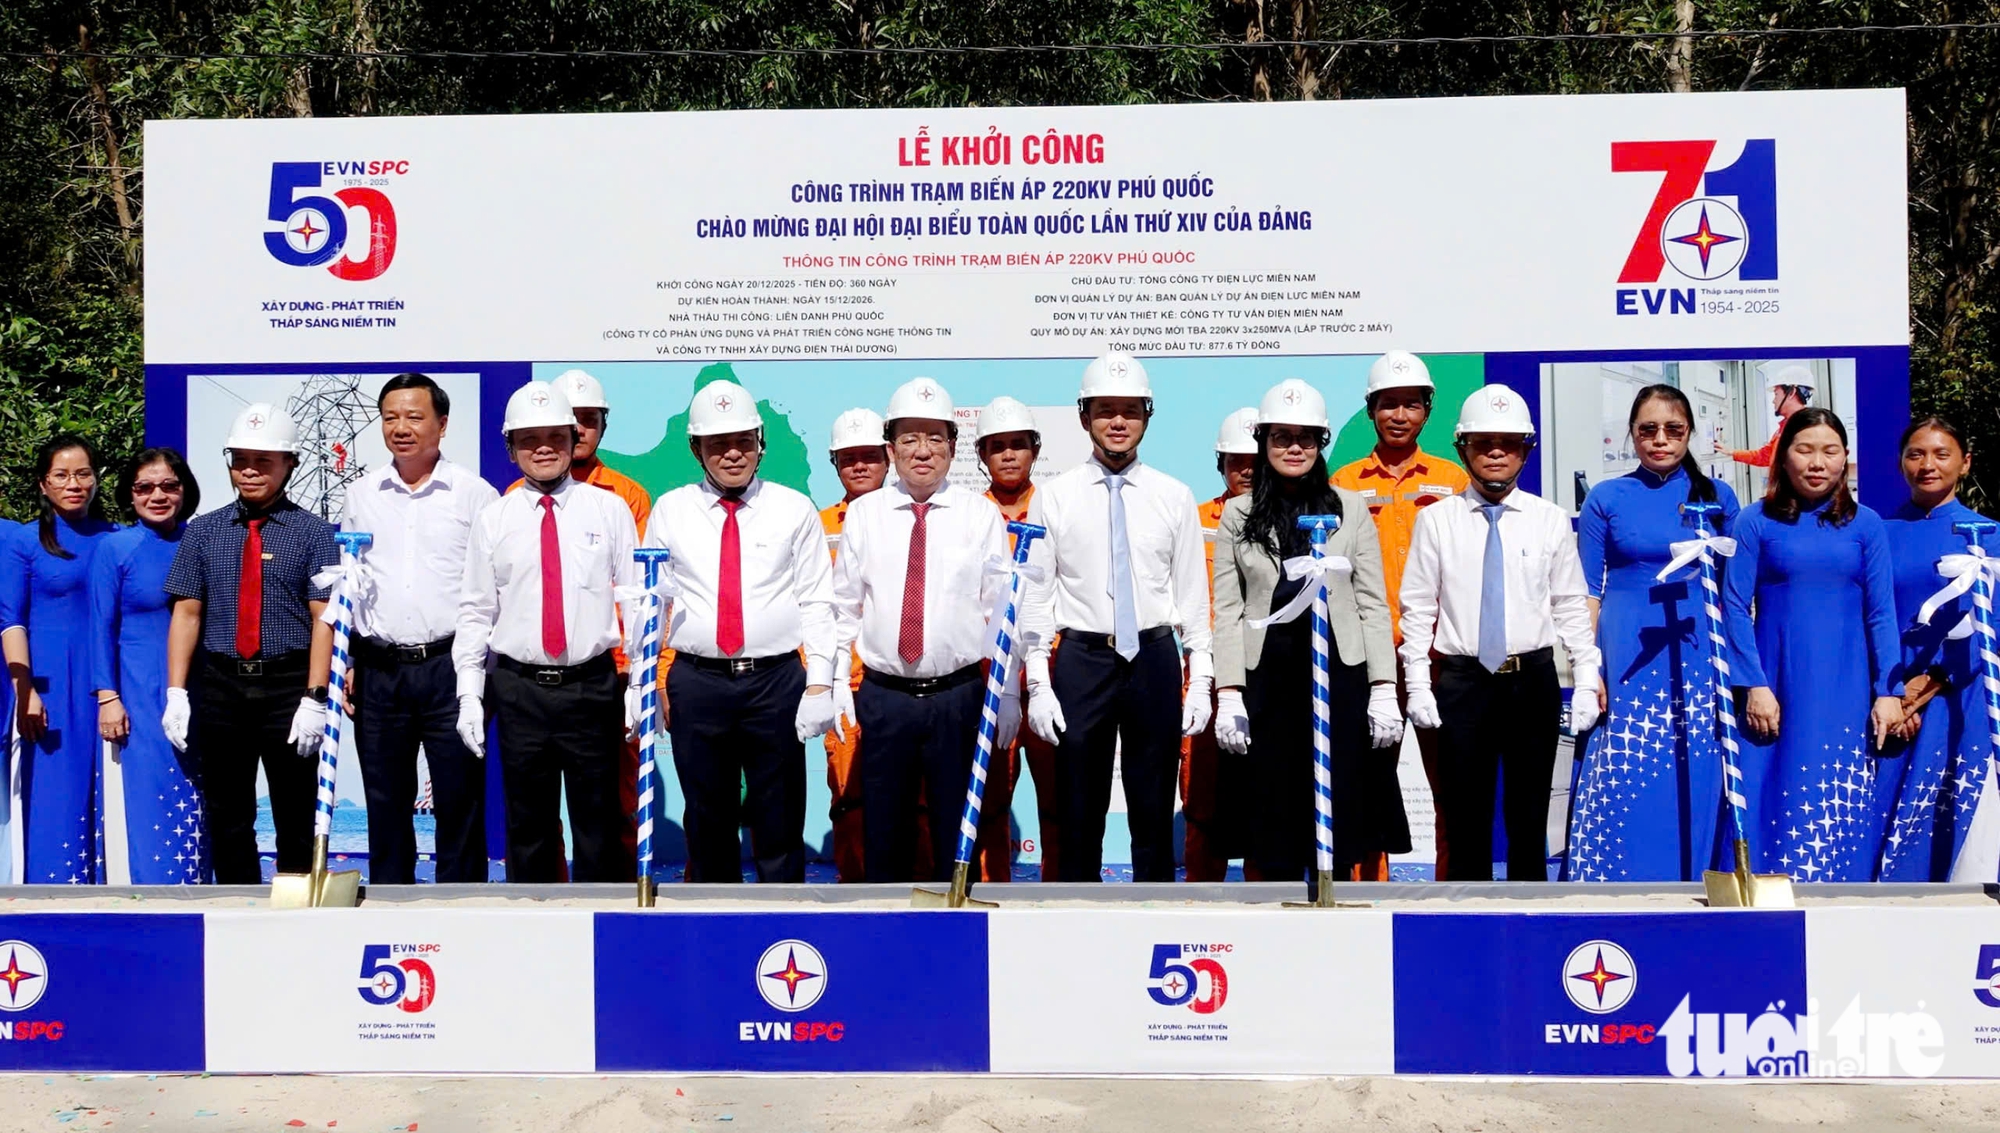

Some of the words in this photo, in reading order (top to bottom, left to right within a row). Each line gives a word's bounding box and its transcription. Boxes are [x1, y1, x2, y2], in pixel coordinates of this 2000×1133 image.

[899, 126, 930, 166] LỄ
[942, 126, 1011, 166] KHỞI
[1023, 128, 1104, 165] CÔNG
[370, 178, 389, 186] 2025
[792, 180, 842, 203] CÔNG
[849, 179, 904, 202] TRÌNH
[911, 182, 963, 205] TRẠM
[971, 176, 1014, 200] BIẾN
[1021, 177, 1046, 200] ÁP
[1053, 180, 1111, 199] 220KV
[1118, 175, 1155, 198] PHÚ
[1163, 171, 1213, 200] QUỐC
[697, 215, 746, 238] CHÀO
[753, 215, 809, 237] MỪNG
[815, 218, 846, 241] ĐẠI
[854, 214, 884, 240] HỘI
[891, 217, 921, 240] ĐẠI
[929, 209, 971, 235] BIỂU
[978, 212, 1027, 235] TOÀN
[1034, 208, 1084, 236] QUỐC
[1092, 208, 1128, 233] LẦN
[1134, 209, 1172, 232] THỨ
[1177, 213, 1207, 232] XIV
[1214, 206, 1252, 231] CỦA
[1259, 205, 1311, 230] ĐẢNG
[783, 254, 833, 267] THÔNG
[839, 256, 860, 267] TIN
[866, 253, 908, 267] CÔNG
[913, 253, 955, 266] TRÌNH
[961, 255, 1001, 268] TRẠM
[1007, 252, 1040, 265] BIẾN
[1045, 251, 1064, 265] ÁP
[1069, 253, 1113, 264] 220KV
[1118, 250, 1147, 264] PHÚ
[1152, 250, 1195, 264] QUỐC
[747, 279, 795, 288] 20/12/2025
[850, 279, 866, 287] 360
[1119, 276, 1135, 284] TƯ:
[1202, 275, 1214, 283] TY
[1294, 273, 1315, 281] NAM
[825, 295, 875, 304] 15/12/2026.
[1035, 294, 1057, 303] ĐƠN
[1060, 294, 1069, 304] VỊ
[1103, 294, 1115, 302] LÝ
[1156, 293, 1176, 302] BAN
[1211, 290, 1223, 301] LÝ
[1338, 290, 1360, 299] NAM
[1616, 288, 1696, 315] EVN
[262, 299, 287, 311] XÂY
[289, 300, 324, 313] DỰNG
[332, 300, 365, 310] PHÁT
[367, 298, 404, 310] TRIỂN
[1701, 302, 1733, 313] 1954
[1744, 301, 1779, 313] 2025
[723, 312, 738, 321] THI
[776, 310, 797, 321] LIÊN
[801, 312, 828, 320] DANH
[832, 310, 852, 320] PHÚ
[1053, 312, 1075, 320] ĐƠN
[1078, 312, 1087, 321] VỊ
[1090, 311, 1104, 320] TƯ
[1212, 310, 1224, 318] TY
[1228, 309, 1242, 318] TƯ
[1321, 308, 1343, 316] NAM
[305, 317, 339, 328] SÁNG
[375, 317, 395, 327] TIN
[638, 329, 650, 337] TY
[936, 327, 951, 335] TIN
[1030, 327, 1051, 336] QUY
[1187, 325, 1207, 334] TBA
[1210, 325, 1239, 334] 220KV
[1243, 325, 1291, 333] 3x250MVA
[1359, 323, 1364, 332] 2
[705, 345, 716, 353] TY
[720, 345, 746, 353] TNHH
[856, 344, 897, 354] DƯƠNG)
[1139, 340, 1161, 350] MỨC
[1189, 341, 1205, 350] TƯ:
[1209, 341, 1233, 350] 877.6
